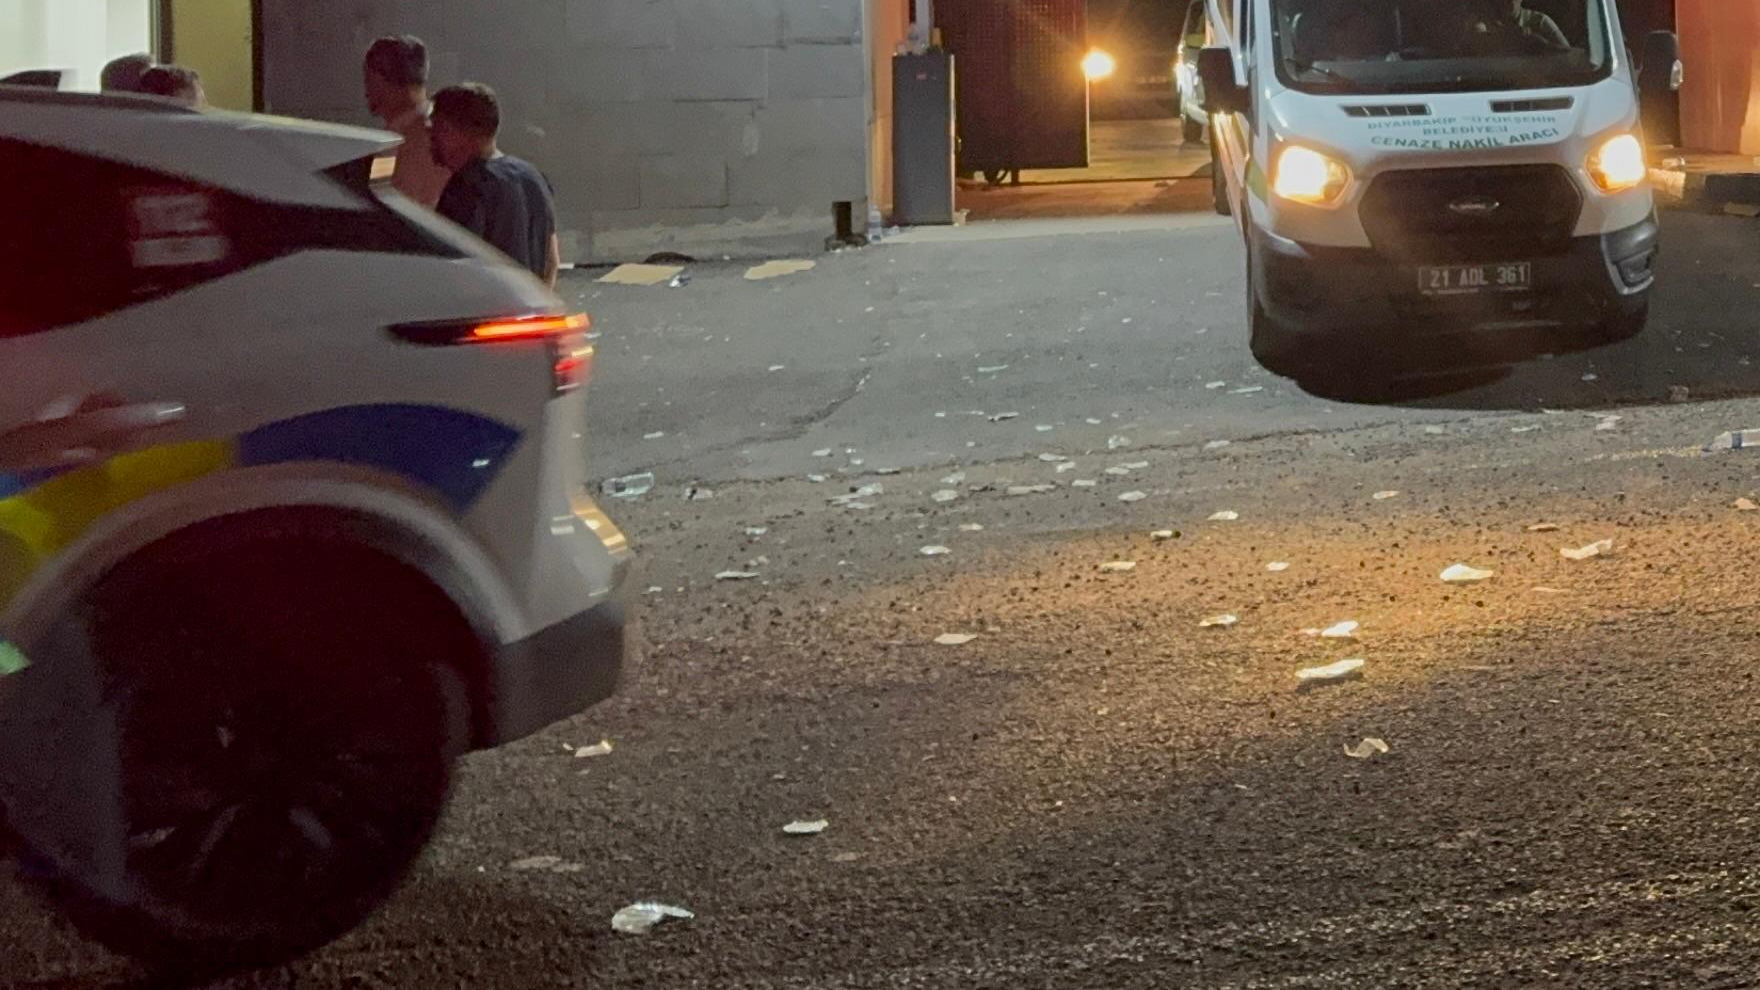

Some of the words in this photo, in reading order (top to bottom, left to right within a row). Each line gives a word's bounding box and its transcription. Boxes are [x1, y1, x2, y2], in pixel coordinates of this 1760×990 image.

[1370, 135, 1443, 149] CENAZE
[1509, 127, 1560, 145] ARACI
[1430, 269, 1450, 288] 21
[1459, 267, 1489, 287] ADL
[1497, 265, 1526, 285] 361
